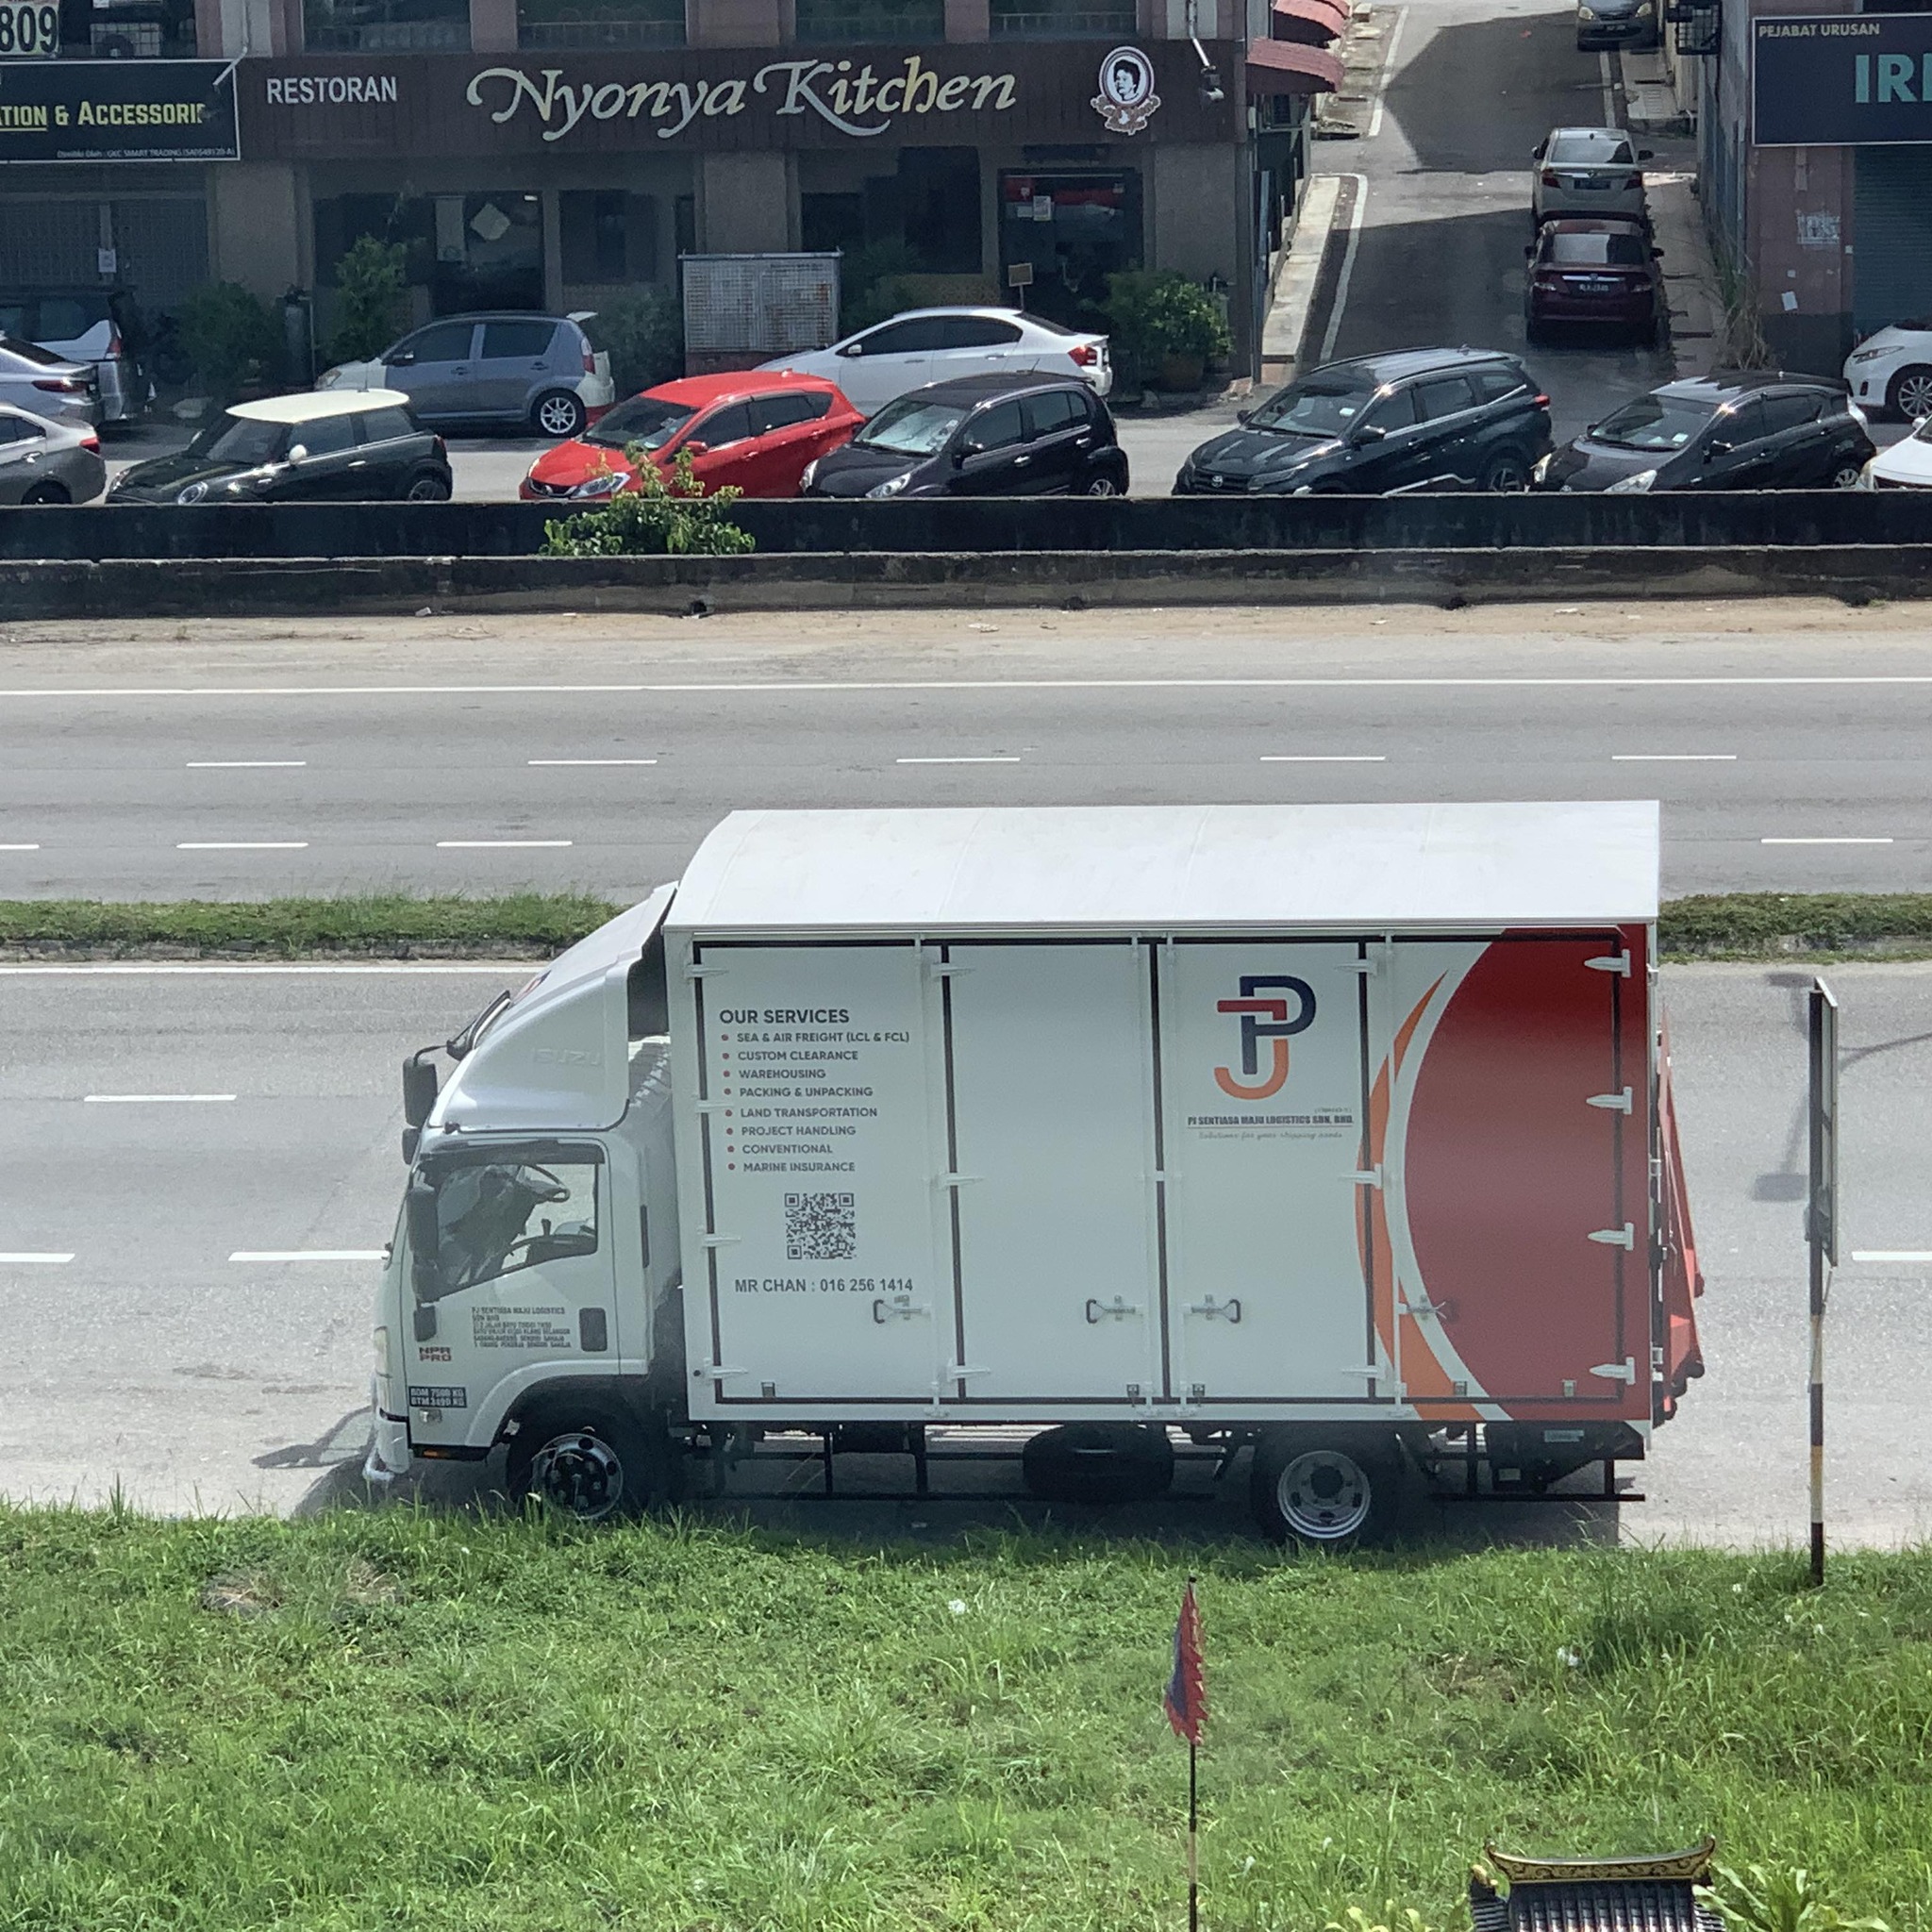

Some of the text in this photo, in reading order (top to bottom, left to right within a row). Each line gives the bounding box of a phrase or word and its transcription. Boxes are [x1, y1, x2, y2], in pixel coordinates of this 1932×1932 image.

[1758, 23, 1880, 38] PEJABAT URUSAN
[266, 75, 397, 104] RESTORAN
[466, 67, 747, 142] Nyonya
[754, 55, 1017, 136] Kitchen
[0, 105, 47, 126] TION
[55, 105, 69, 125] &
[719, 1008, 850, 1024] OUR SERVICES
[737, 1031, 910, 1043] SEA & AIR FREIGHT (LCL & FCL)
[738, 1050, 858, 1061] CUSTOM CLEARANCE
[739, 1069, 826, 1079] WAREHOUSING
[740, 1087, 874, 1097] PACKING & UNPACKING
[741, 1107, 878, 1118] LAND TRANSPORTATION
[1266, 1115, 1311, 1124] LOGISTICS
[741, 1125, 857, 1136] PROJECT HANDLING
[741, 1144, 833, 1154] CONVENTIONAL
[742, 1161, 856, 1173] MARINE INSURANCE
[735, 1278, 758, 1292] MR
[762, 1278, 807, 1292] CHAN
[820, 1278, 845, 1292] 016
[849, 1278, 874, 1291] 256
[881, 1278, 913, 1291] 1414
